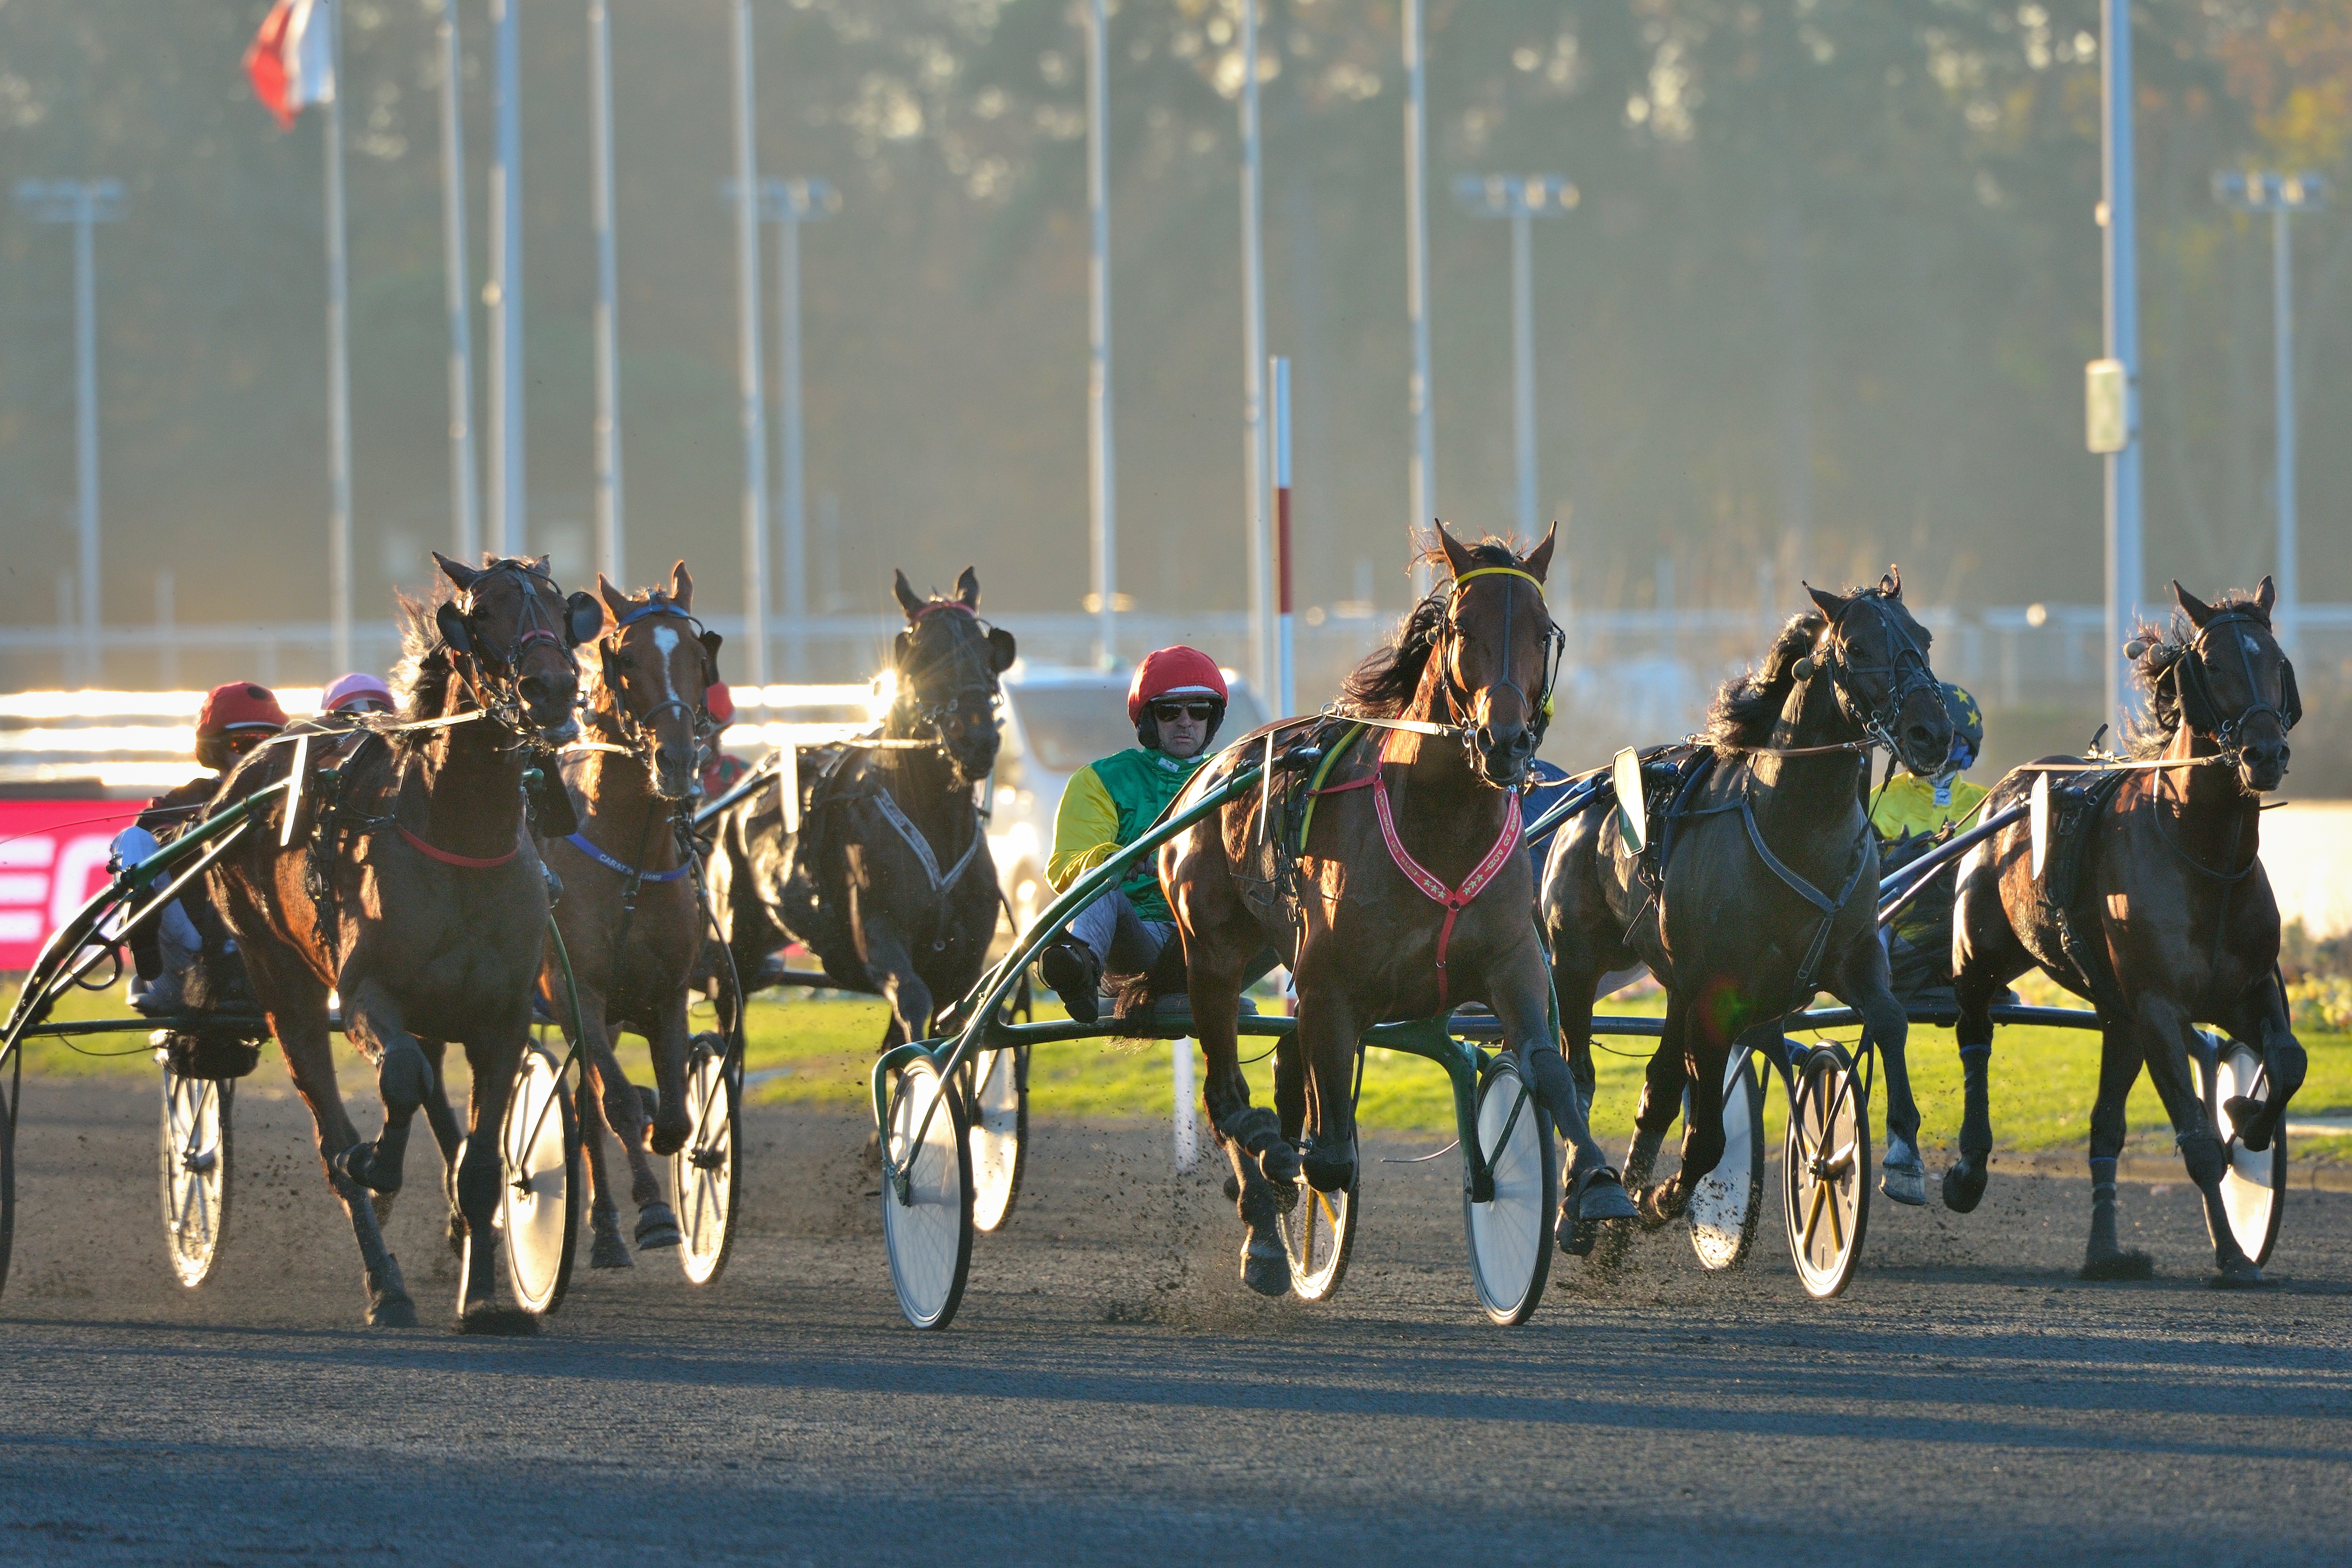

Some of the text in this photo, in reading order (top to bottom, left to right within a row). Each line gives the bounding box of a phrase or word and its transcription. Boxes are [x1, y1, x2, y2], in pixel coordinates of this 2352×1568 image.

[1504, 834, 1512, 846] DU
[599, 854, 662, 881] CARAT WLIAMS
[1391, 840, 1399, 853] DU
[1400, 856, 1421, 877] PONT
[1485, 849, 1503, 872] PONT
